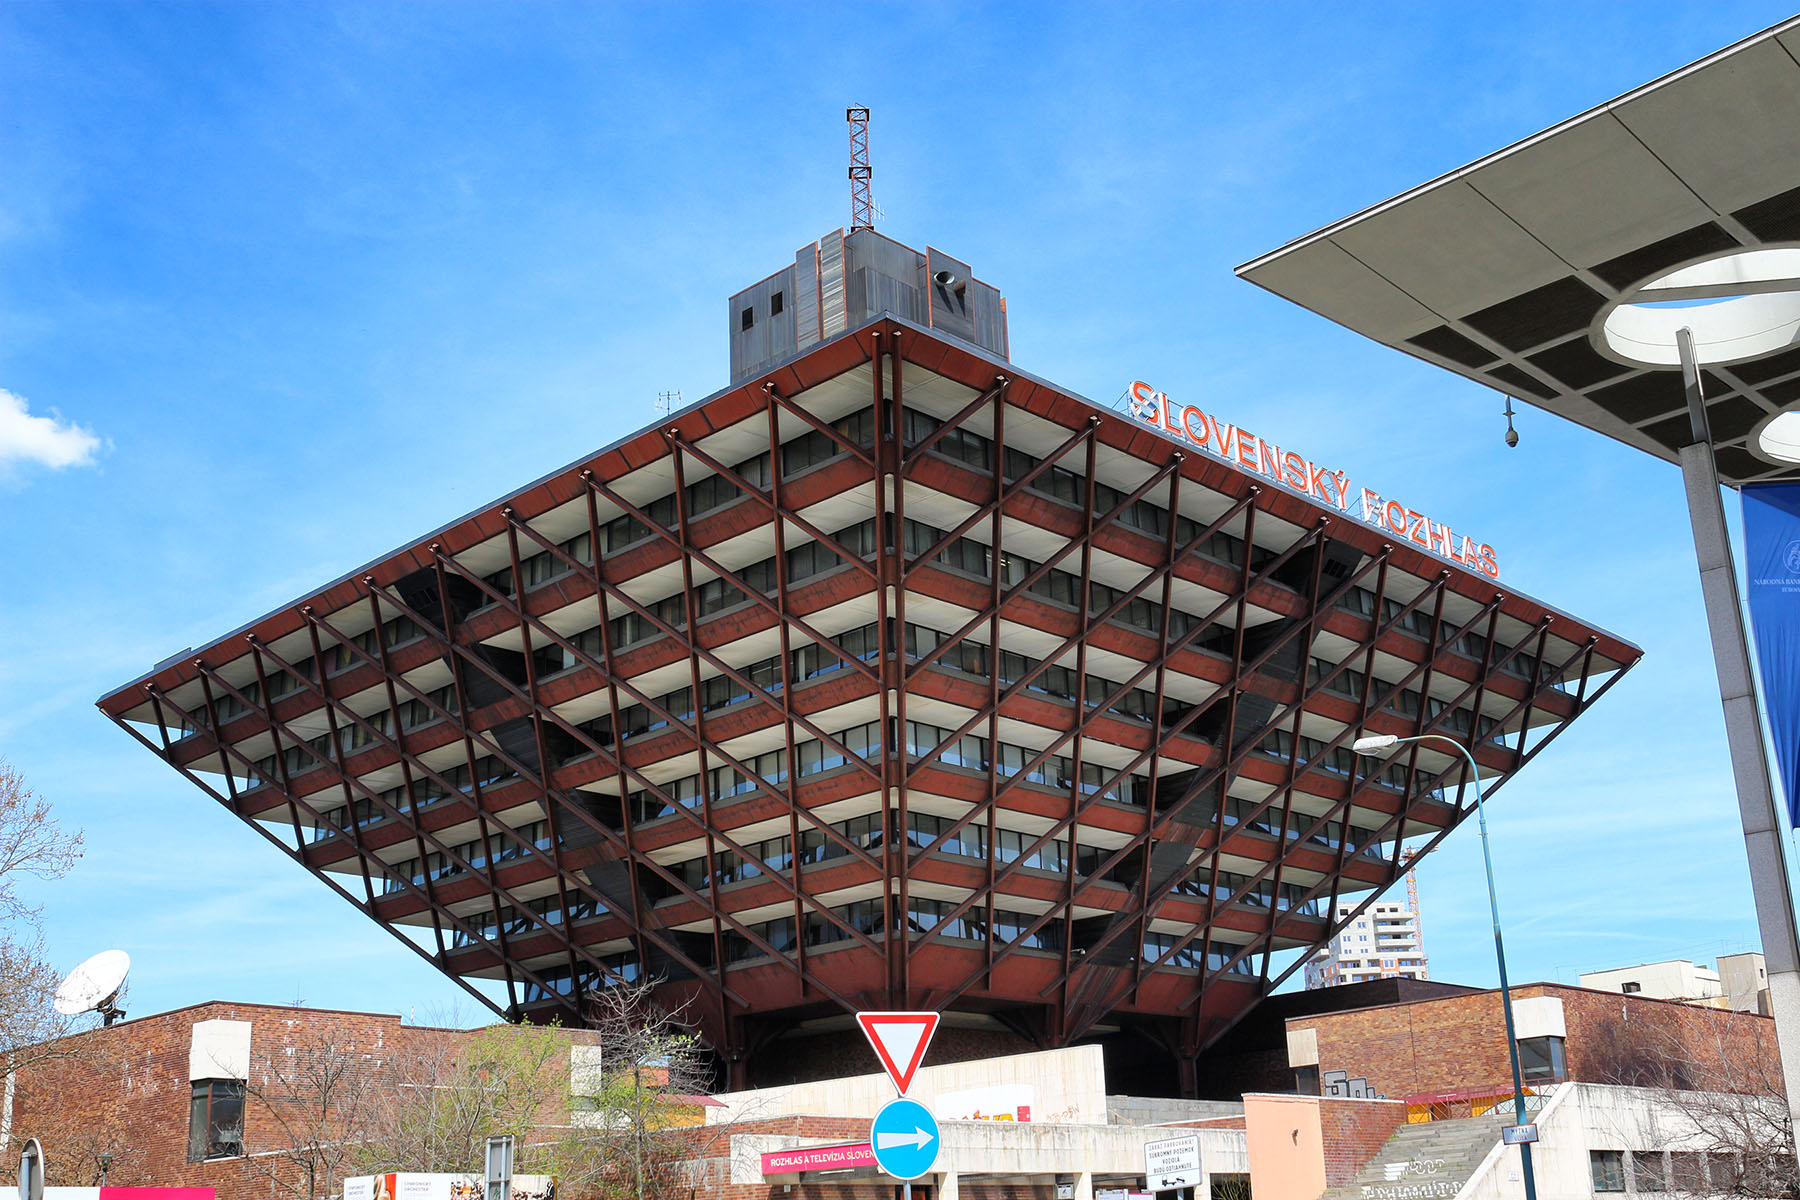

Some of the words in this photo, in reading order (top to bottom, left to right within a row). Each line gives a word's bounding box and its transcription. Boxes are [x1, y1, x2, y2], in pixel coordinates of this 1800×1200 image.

[1129, 381, 1351, 510] SLOVENSKÝ
[1361, 487, 1499, 579] ROZHLAS
[770, 1156, 802, 1167] ROZHLAS
[810, 1151, 845, 1163] TELEVÍZIA
